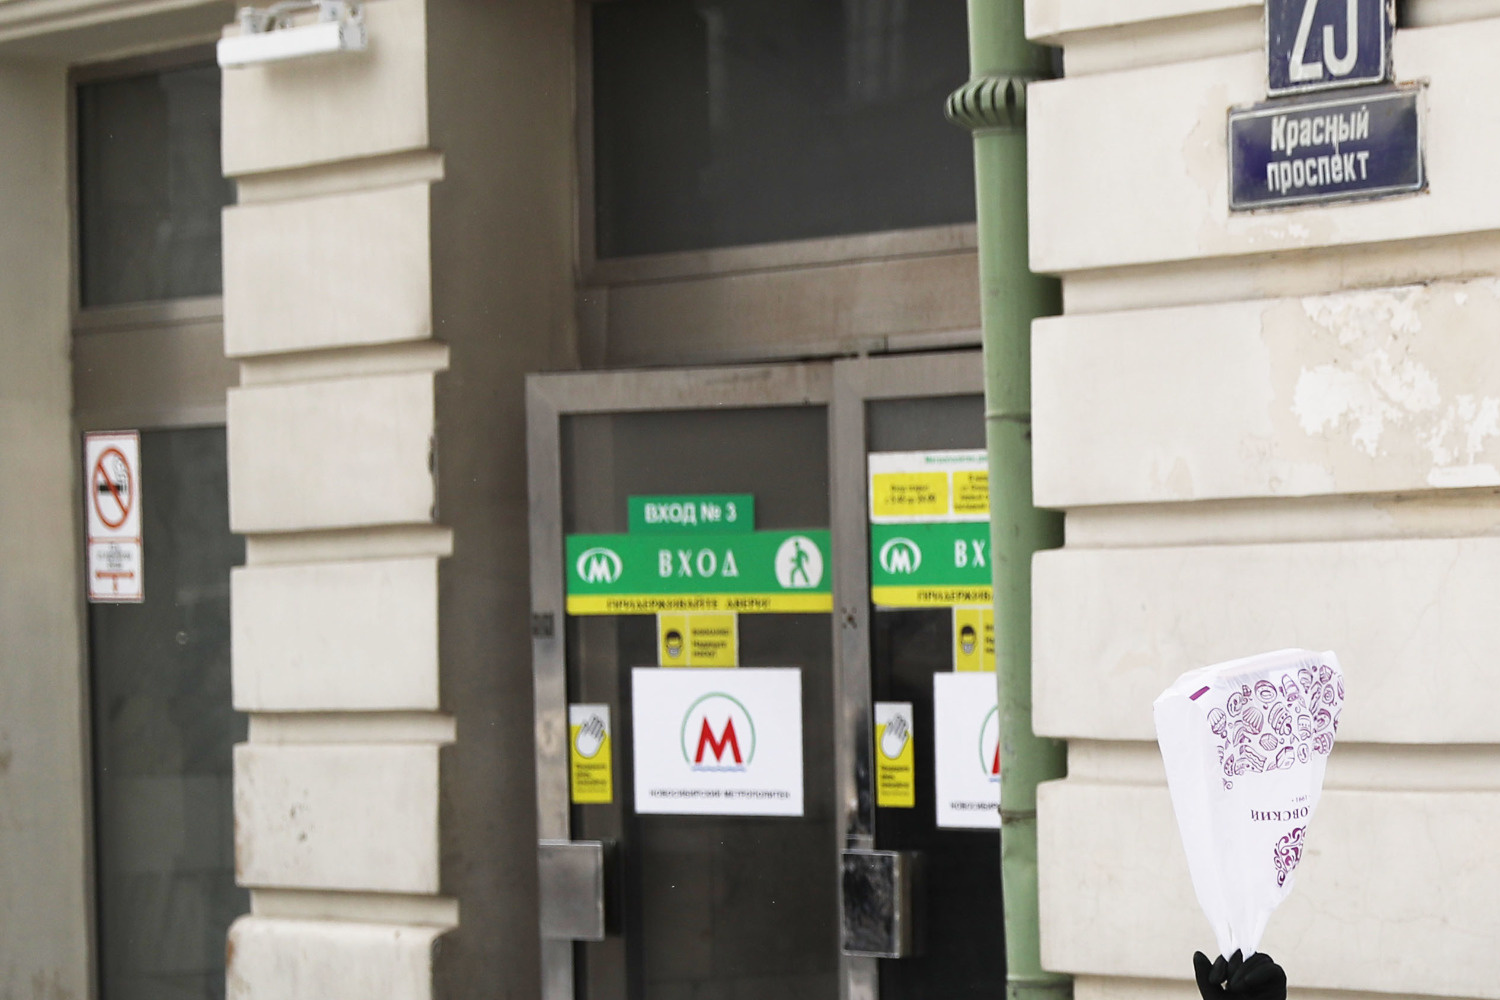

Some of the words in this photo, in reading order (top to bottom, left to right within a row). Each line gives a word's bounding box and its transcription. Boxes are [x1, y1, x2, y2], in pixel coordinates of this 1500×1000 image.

[1271, 105, 1370, 157] Красный
[1266, 150, 1370, 195] проспект
[644, 502, 697, 526] ВХОД
[700, 502, 721, 522] №
[726, 502, 737, 523] 3
[658, 548, 739, 578] ВХОД
[954, 538, 991, 569] ВХ
[694, 715, 743, 765] М
[1250, 805, 1310, 822] ОВСКИЙ
